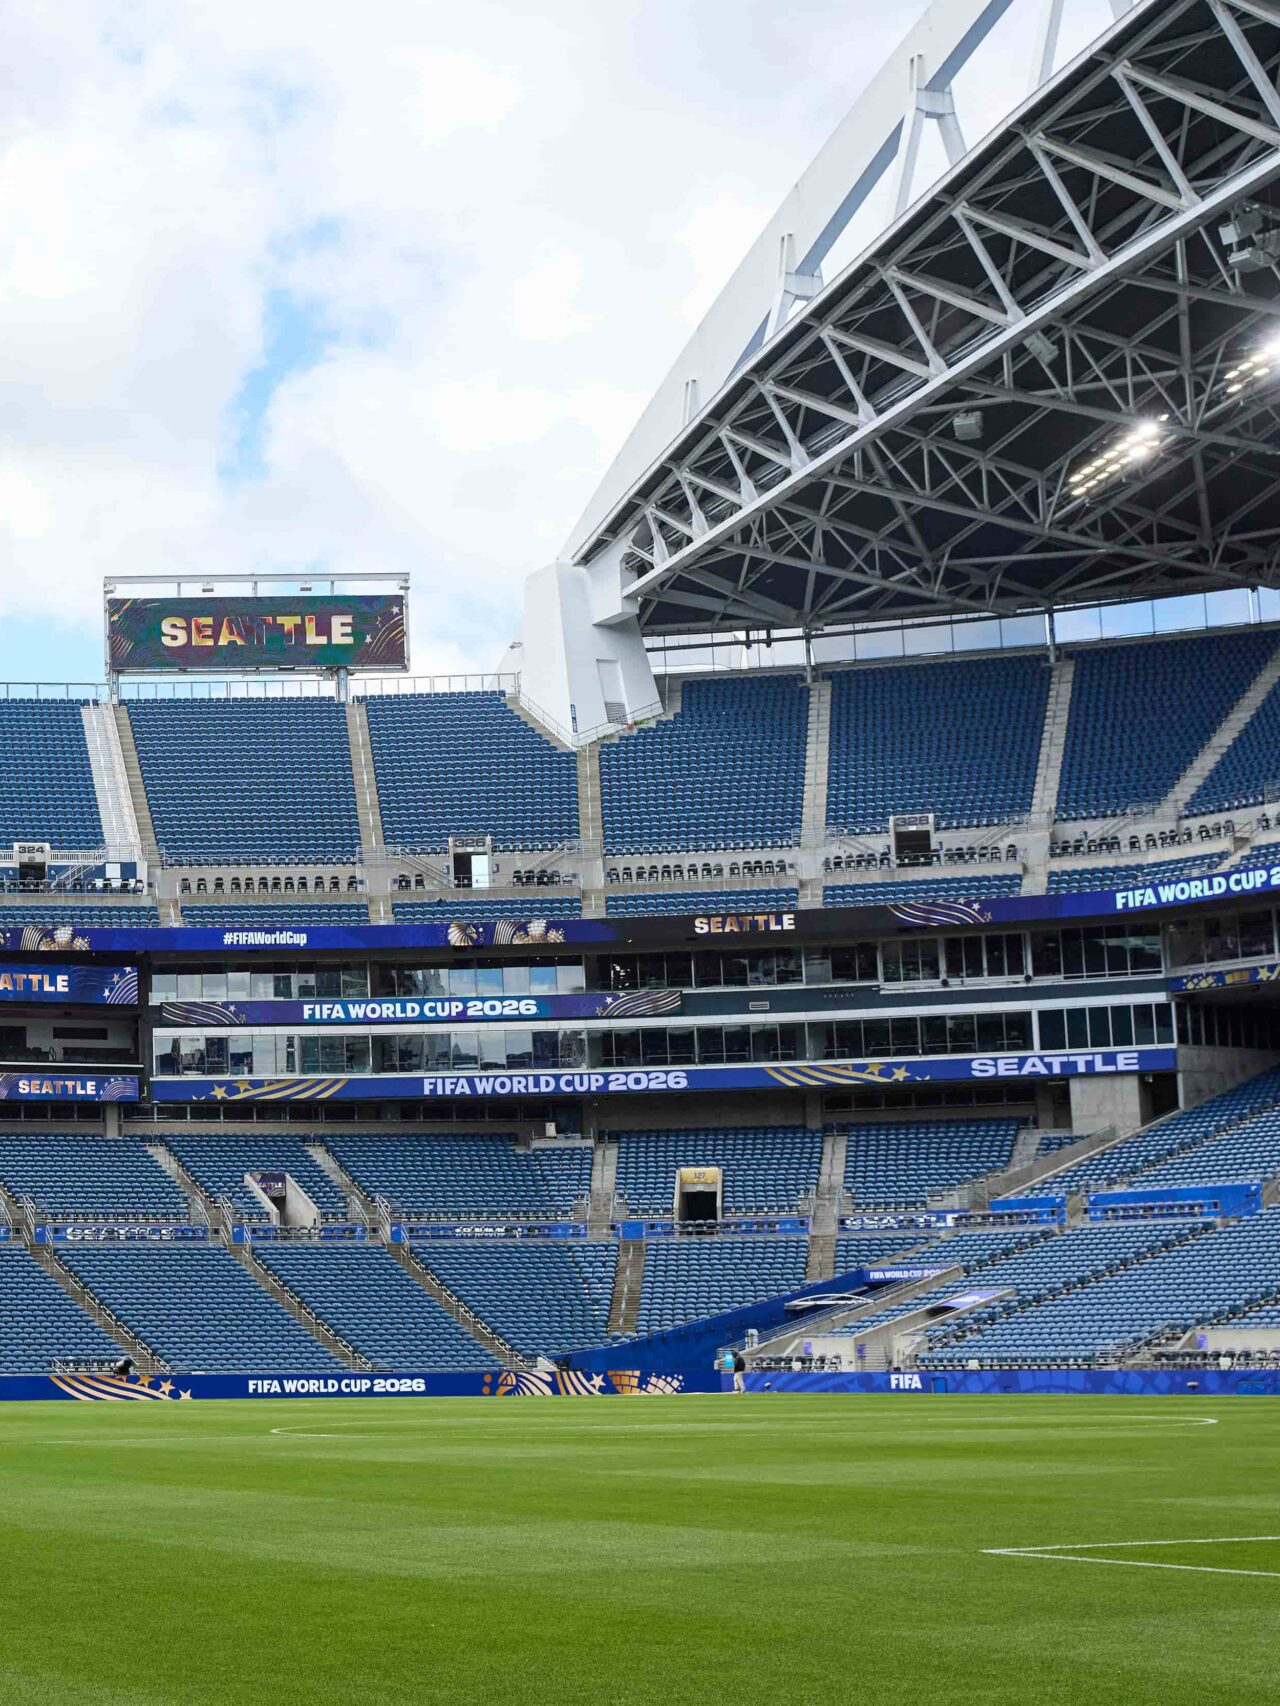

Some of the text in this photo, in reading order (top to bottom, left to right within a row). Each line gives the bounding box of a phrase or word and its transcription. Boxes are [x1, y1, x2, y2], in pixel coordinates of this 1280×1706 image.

[160, 614, 354, 647] SEATTLE
[896, 816, 929, 827] 328
[18, 846, 45, 854] 324
[454, 838, 486, 848] 326
[1115, 887, 1157, 909] FIFA
[1158, 876, 1227, 902] WORLD
[1229, 869, 1268, 891] CUP
[694, 913, 796, 934] SEATTLE
[223, 932, 307, 947] #FIFAWorldCup
[303, 999, 537, 1020] FIFA WORLD CUP 2026
[971, 1052, 1139, 1077] SEATTLE
[18, 1080, 97, 1095] SEATTLE
[423, 1071, 689, 1096] FIFA WORLD CUP 2026
[885, 1270, 909, 1279] WORLD
[248, 1378, 426, 1393] FIFA WORLD CUP 2026
[890, 1374, 922, 1390] FIFA
